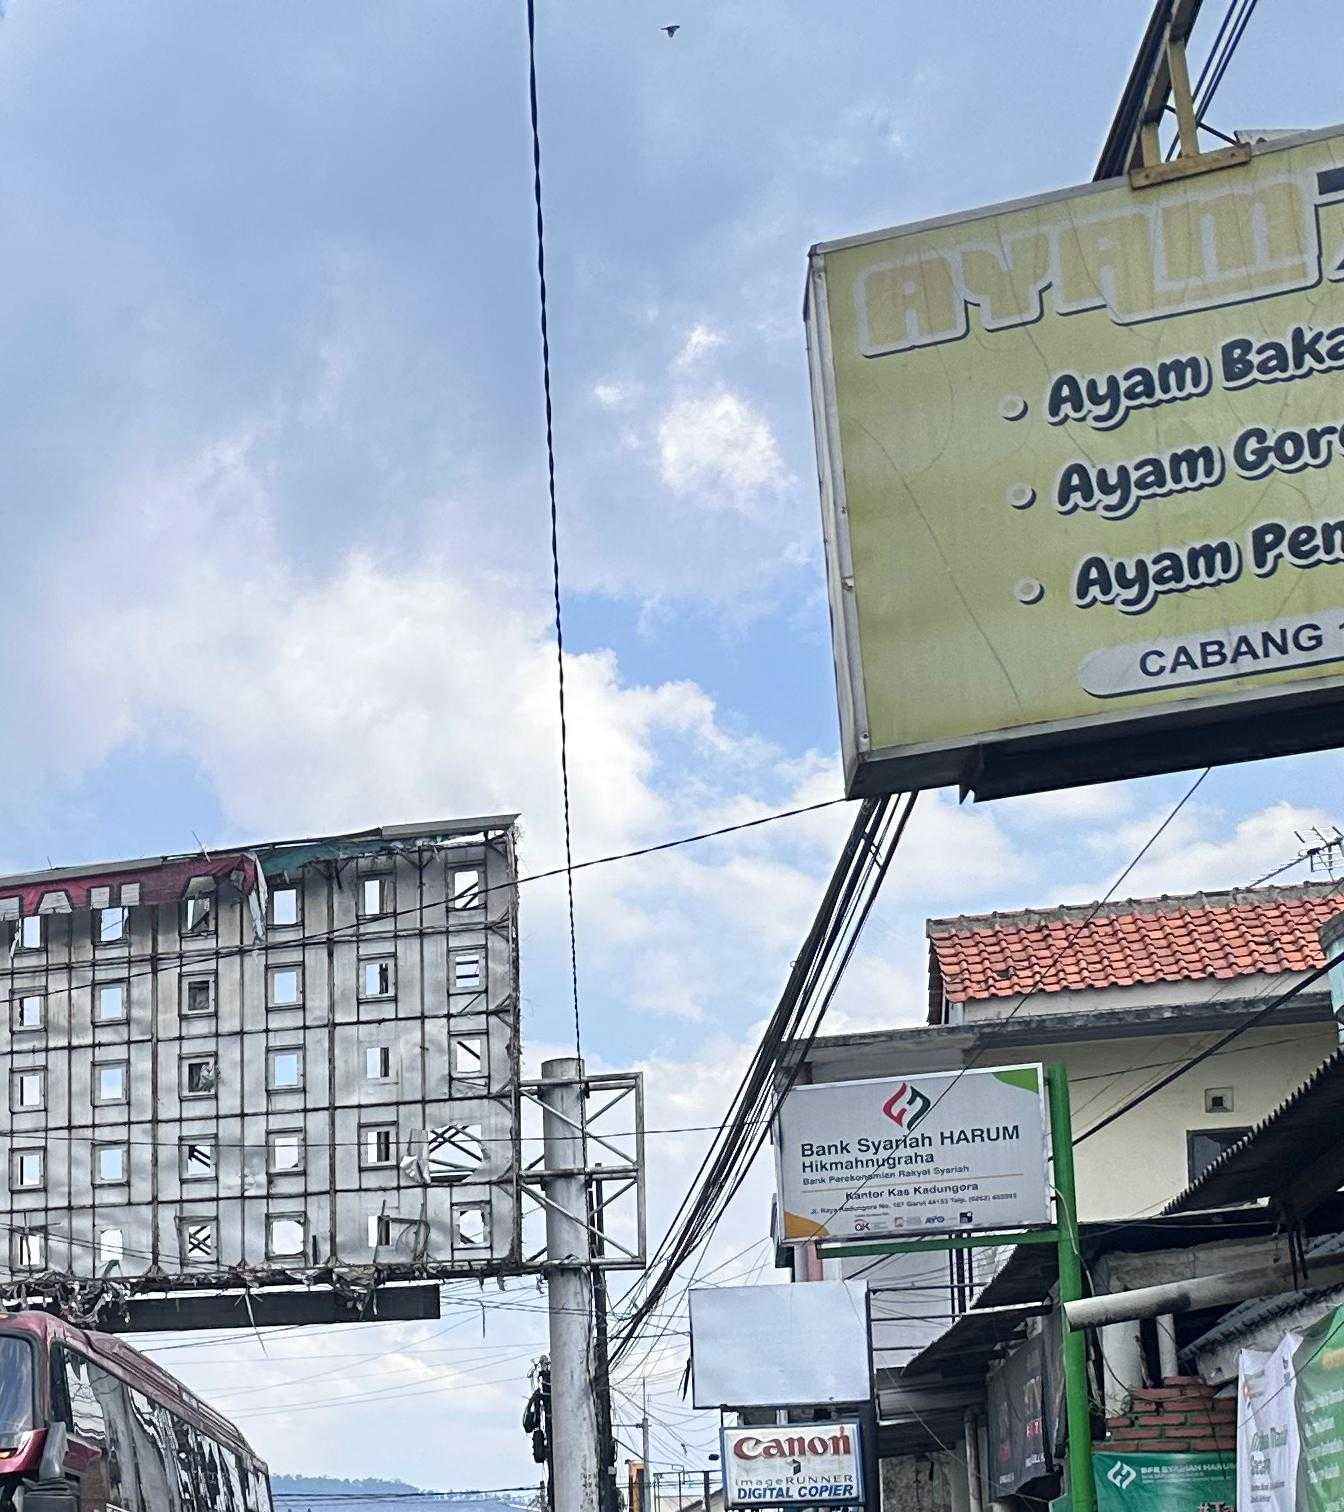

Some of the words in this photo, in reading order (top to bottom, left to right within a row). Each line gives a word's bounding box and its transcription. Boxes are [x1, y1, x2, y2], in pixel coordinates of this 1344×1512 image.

[1047, 355, 1204, 424] Ayam
[1057, 445, 1216, 515] Ayam
[1232, 424, 1344, 474] Gor
[1074, 540, 1234, 610] Ayam
[1138, 623, 1325, 678] CABANG
[800, 1140, 850, 1158] Bank
[857, 1132, 933, 1154] Syariah
[939, 1124, 1020, 1146] HARUM
[801, 1151, 935, 1174] Hikmahnugraha
[802, 1176, 826, 1186] Bank
[933, 1165, 970, 1177] Syariah
[845, 1188, 886, 1201] Kantor
[887, 1187, 910, 1197] Kas
[913, 1183, 979, 1196] Kadungora
[733, 1434, 851, 1461] Canon
[737, 1486, 794, 1501] DIGITAL
[797, 1484, 854, 1498] COPIER
